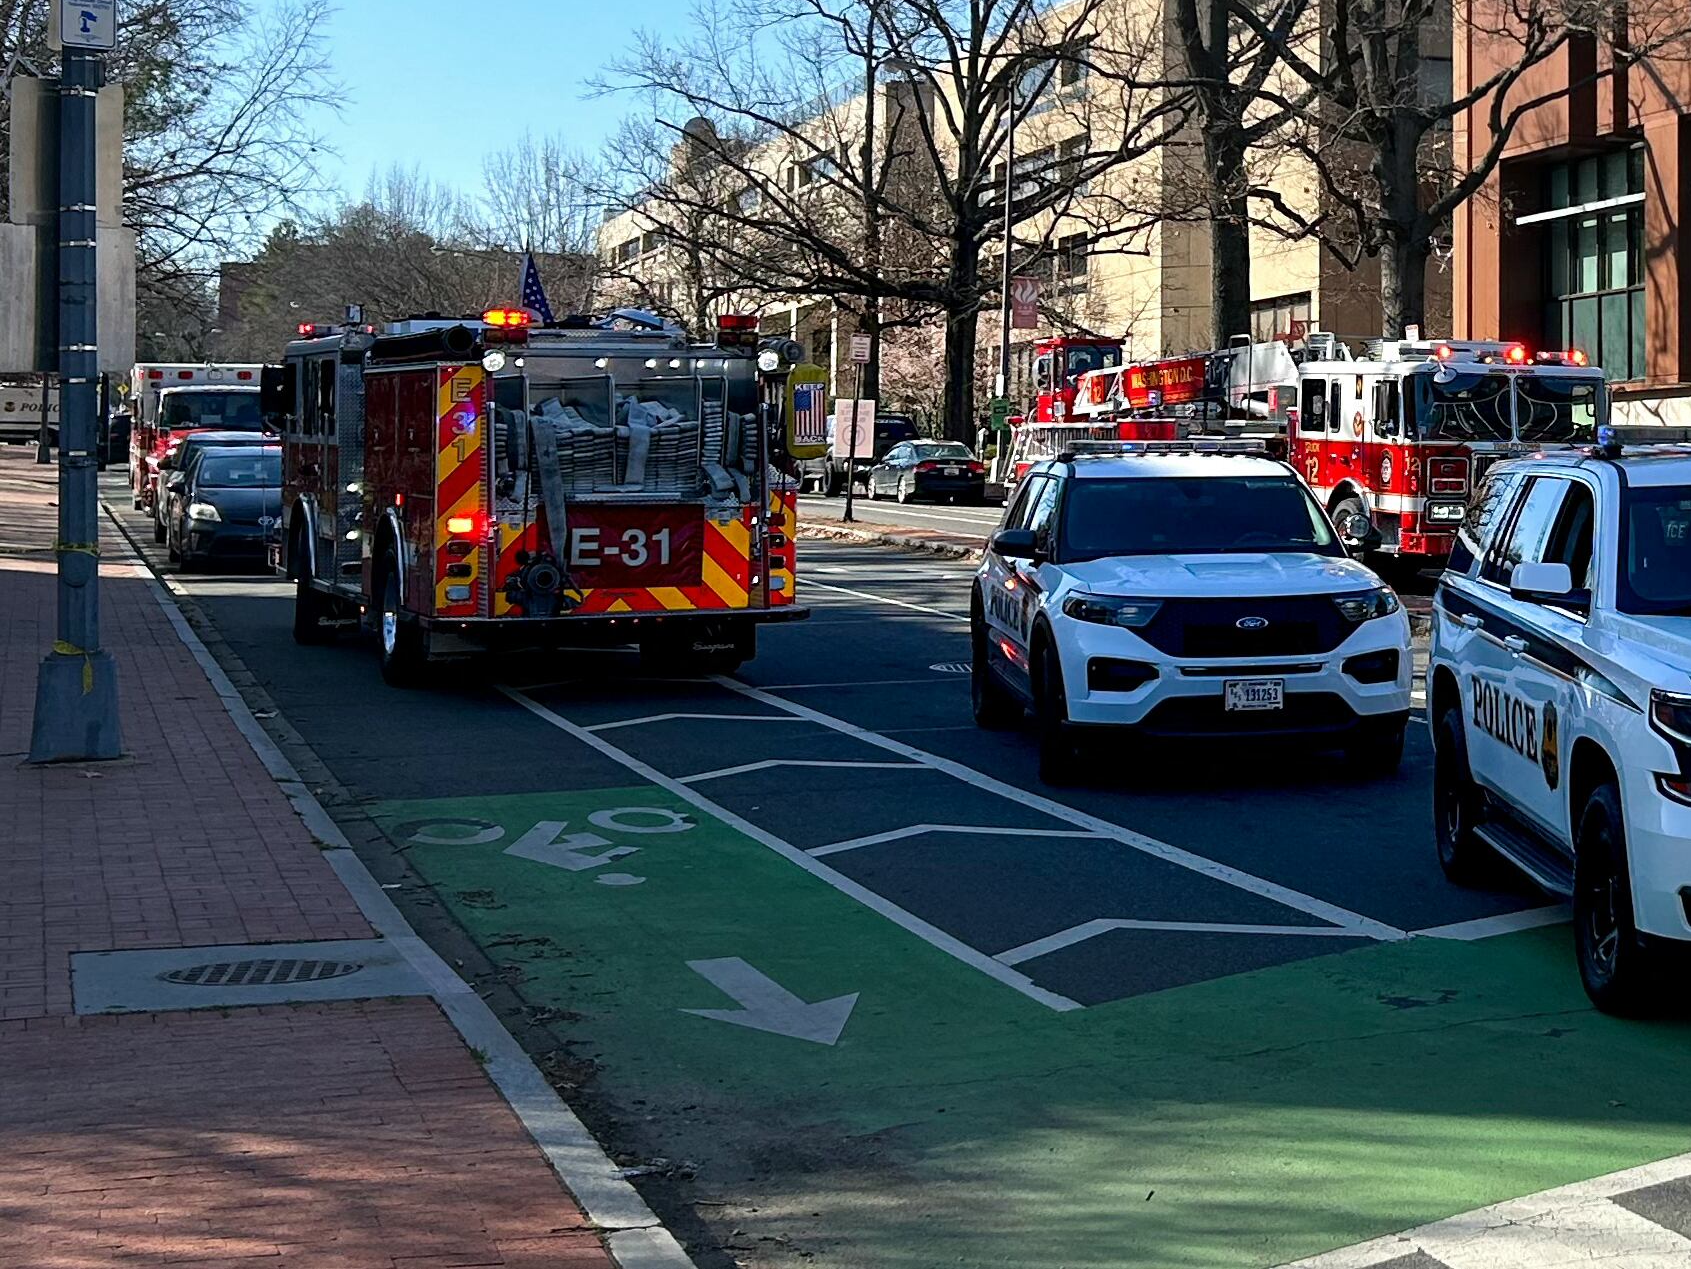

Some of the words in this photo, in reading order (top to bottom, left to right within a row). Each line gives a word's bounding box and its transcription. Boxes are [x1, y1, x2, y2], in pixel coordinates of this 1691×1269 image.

[794, 383, 825, 391] KEEP
[794, 435, 825, 443] BACK
[1305, 455, 1319, 483] 12
[570, 527, 670, 567] E-31
[1245, 687, 1278, 702] 131253
[1471, 674, 1539, 765] POLICE
